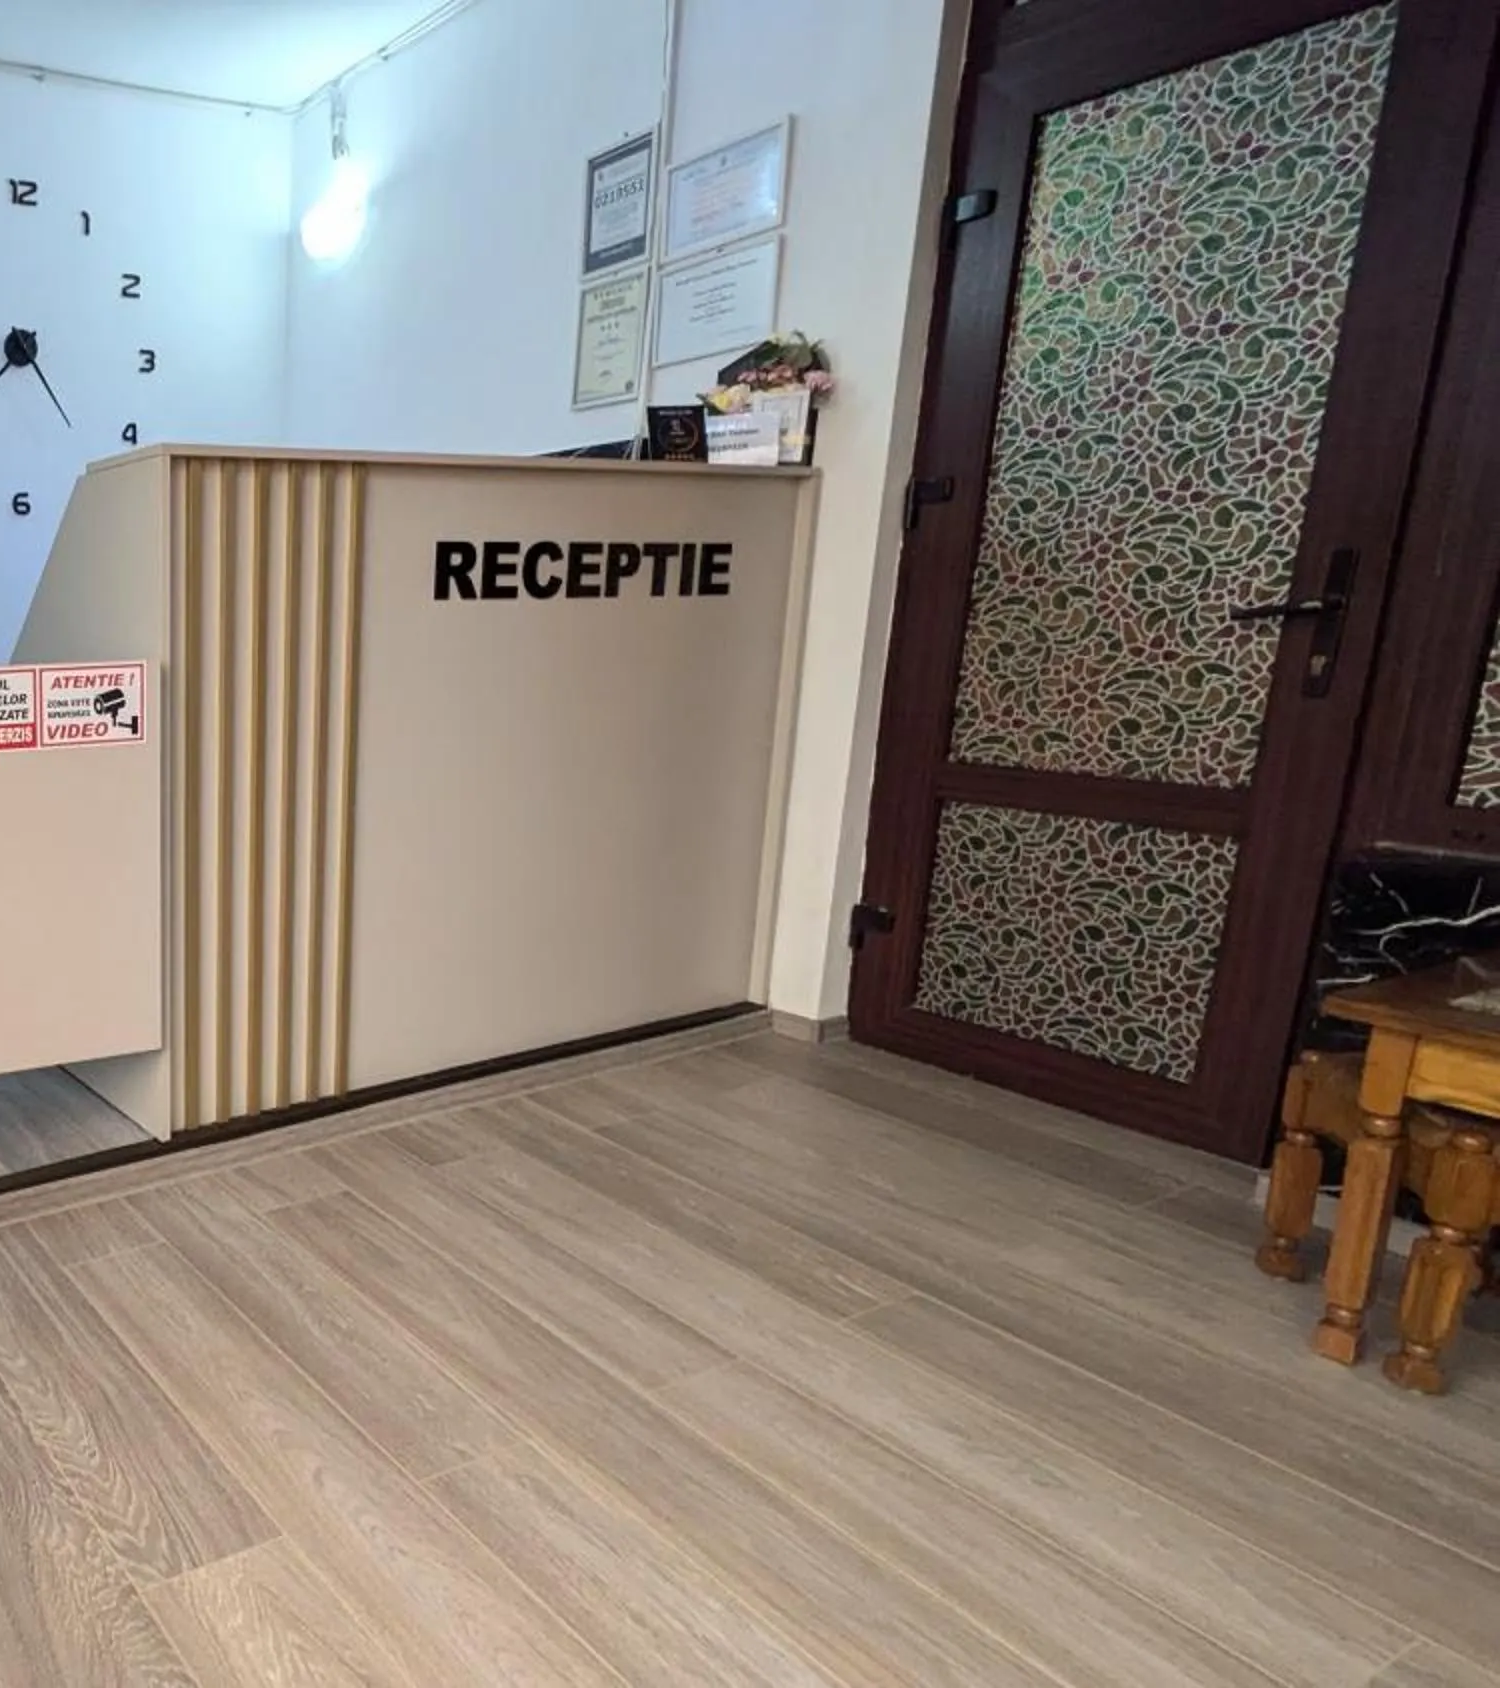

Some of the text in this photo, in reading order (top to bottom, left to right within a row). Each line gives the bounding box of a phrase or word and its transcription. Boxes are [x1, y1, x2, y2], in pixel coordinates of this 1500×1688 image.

[9, 178, 38, 207] 12
[80, 210, 91, 236] 1
[120, 273, 141, 299] 2
[138, 349, 156, 374] 3
[121, 422, 138, 446] 4
[11, 491, 31, 517] 6
[433, 541, 733, 600] RECEPTIE
[51, 673, 125, 690] ATENTIE
[47, 721, 109, 740] VIDEO
